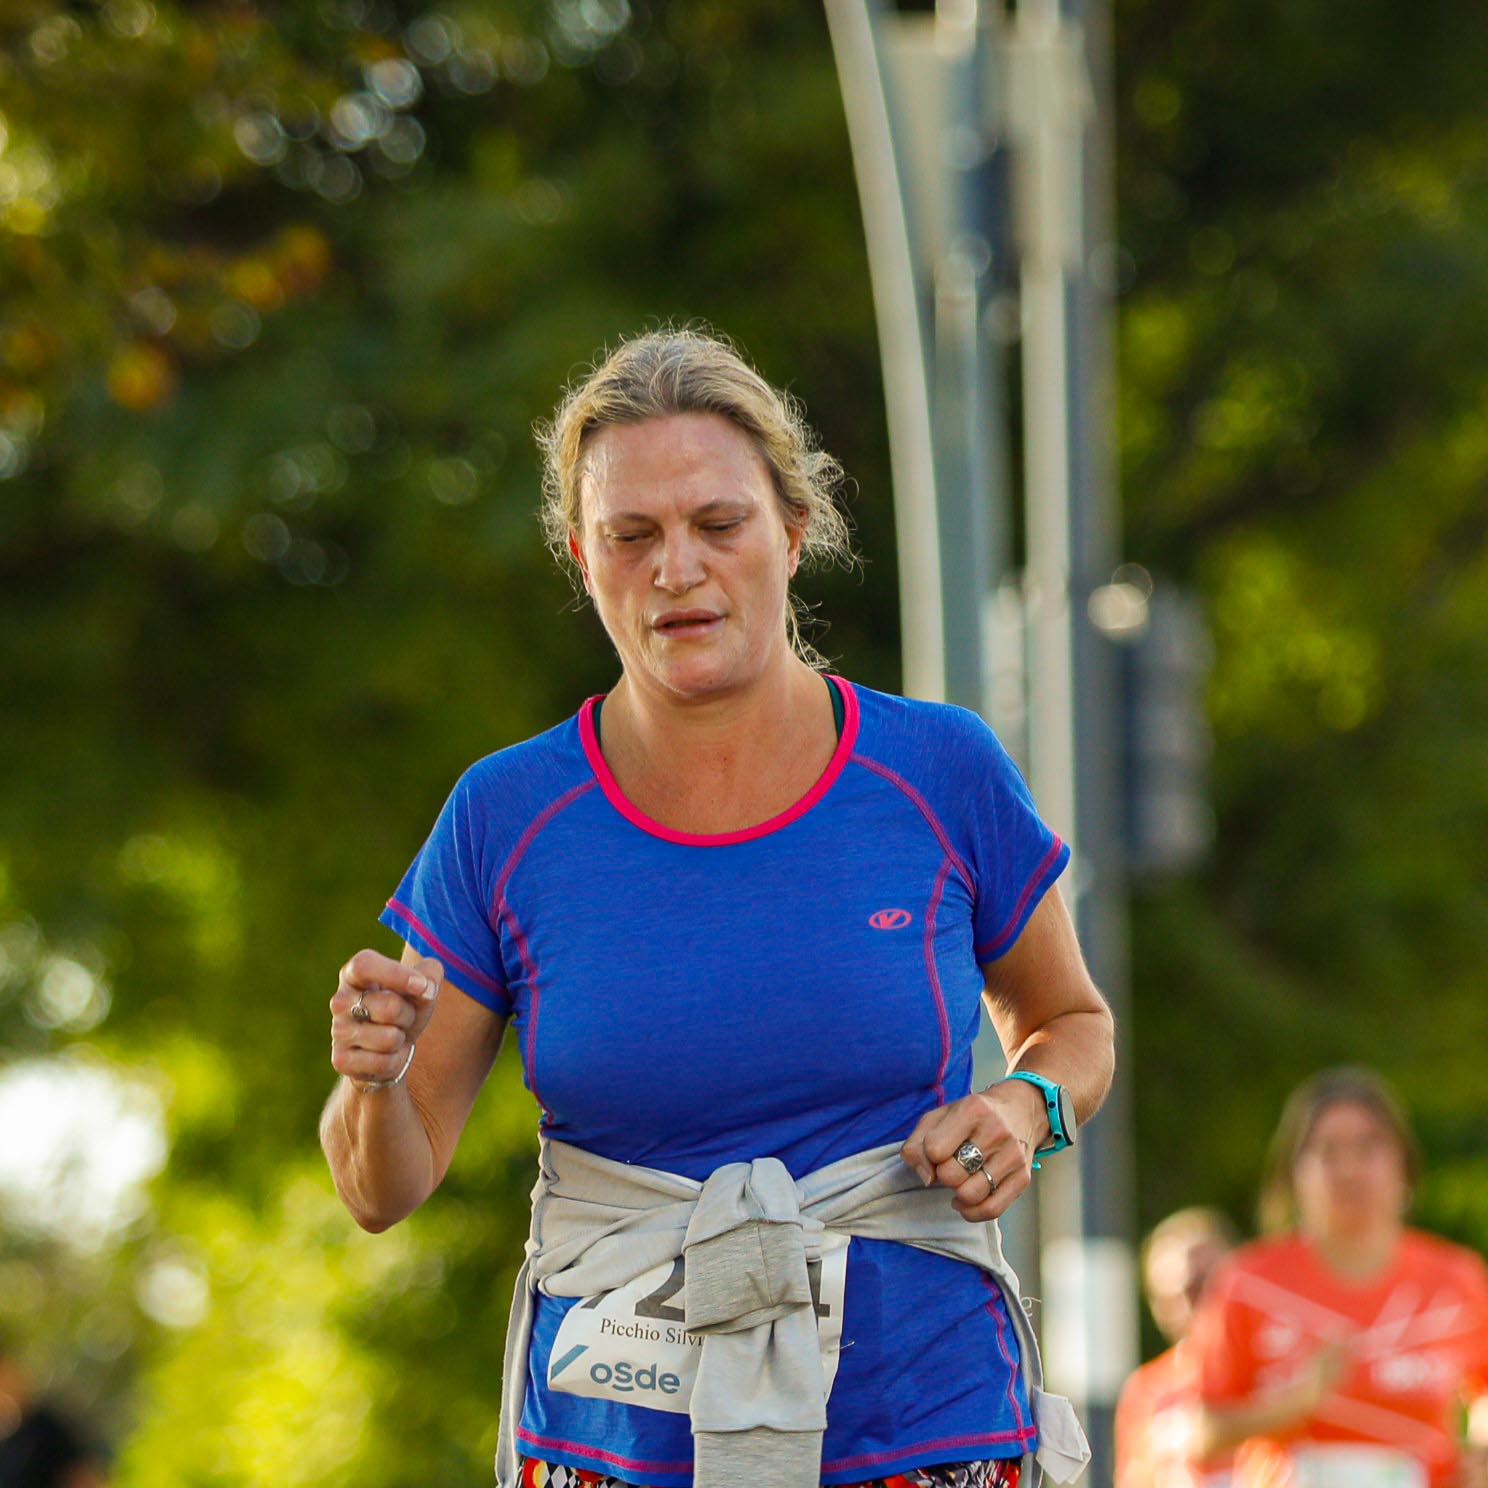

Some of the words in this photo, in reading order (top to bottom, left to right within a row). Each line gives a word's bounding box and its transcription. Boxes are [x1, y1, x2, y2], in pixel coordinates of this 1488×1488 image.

[600, 1317, 661, 1342] Picchio
[665, 1326, 705, 1347] Silvi
[589, 1361, 681, 1395] osde
